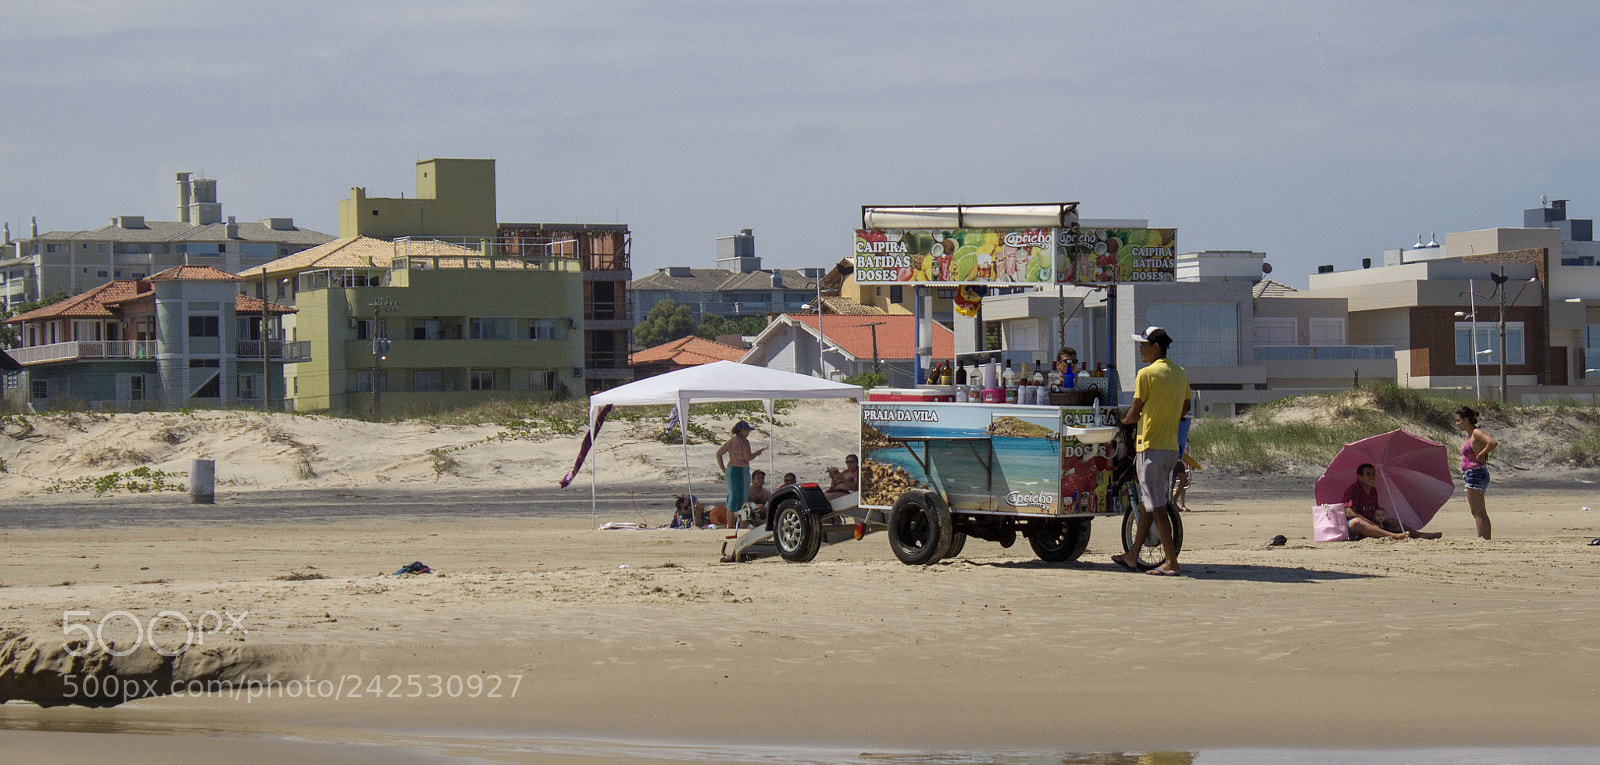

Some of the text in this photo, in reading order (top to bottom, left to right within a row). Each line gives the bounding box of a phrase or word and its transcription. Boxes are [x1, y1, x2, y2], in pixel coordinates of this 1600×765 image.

[1004, 229, 1052, 247] Capricho
[1057, 230, 1096, 246] Caprcho
[856, 241, 908, 253] CAIPIRA
[1131, 246, 1173, 257] CAIPIRA
[857, 255, 911, 268] BATIDAS
[1132, 258, 1175, 268] BATIDAS
[857, 269, 898, 281] DOSES
[1132, 271, 1164, 281] DOSES
[863, 409, 938, 422] PRAIA DA VILA
[1064, 413, 1117, 425] CAIPRA
[1064, 445, 1107, 458] DOSS
[1006, 490, 1053, 506] Capricho
